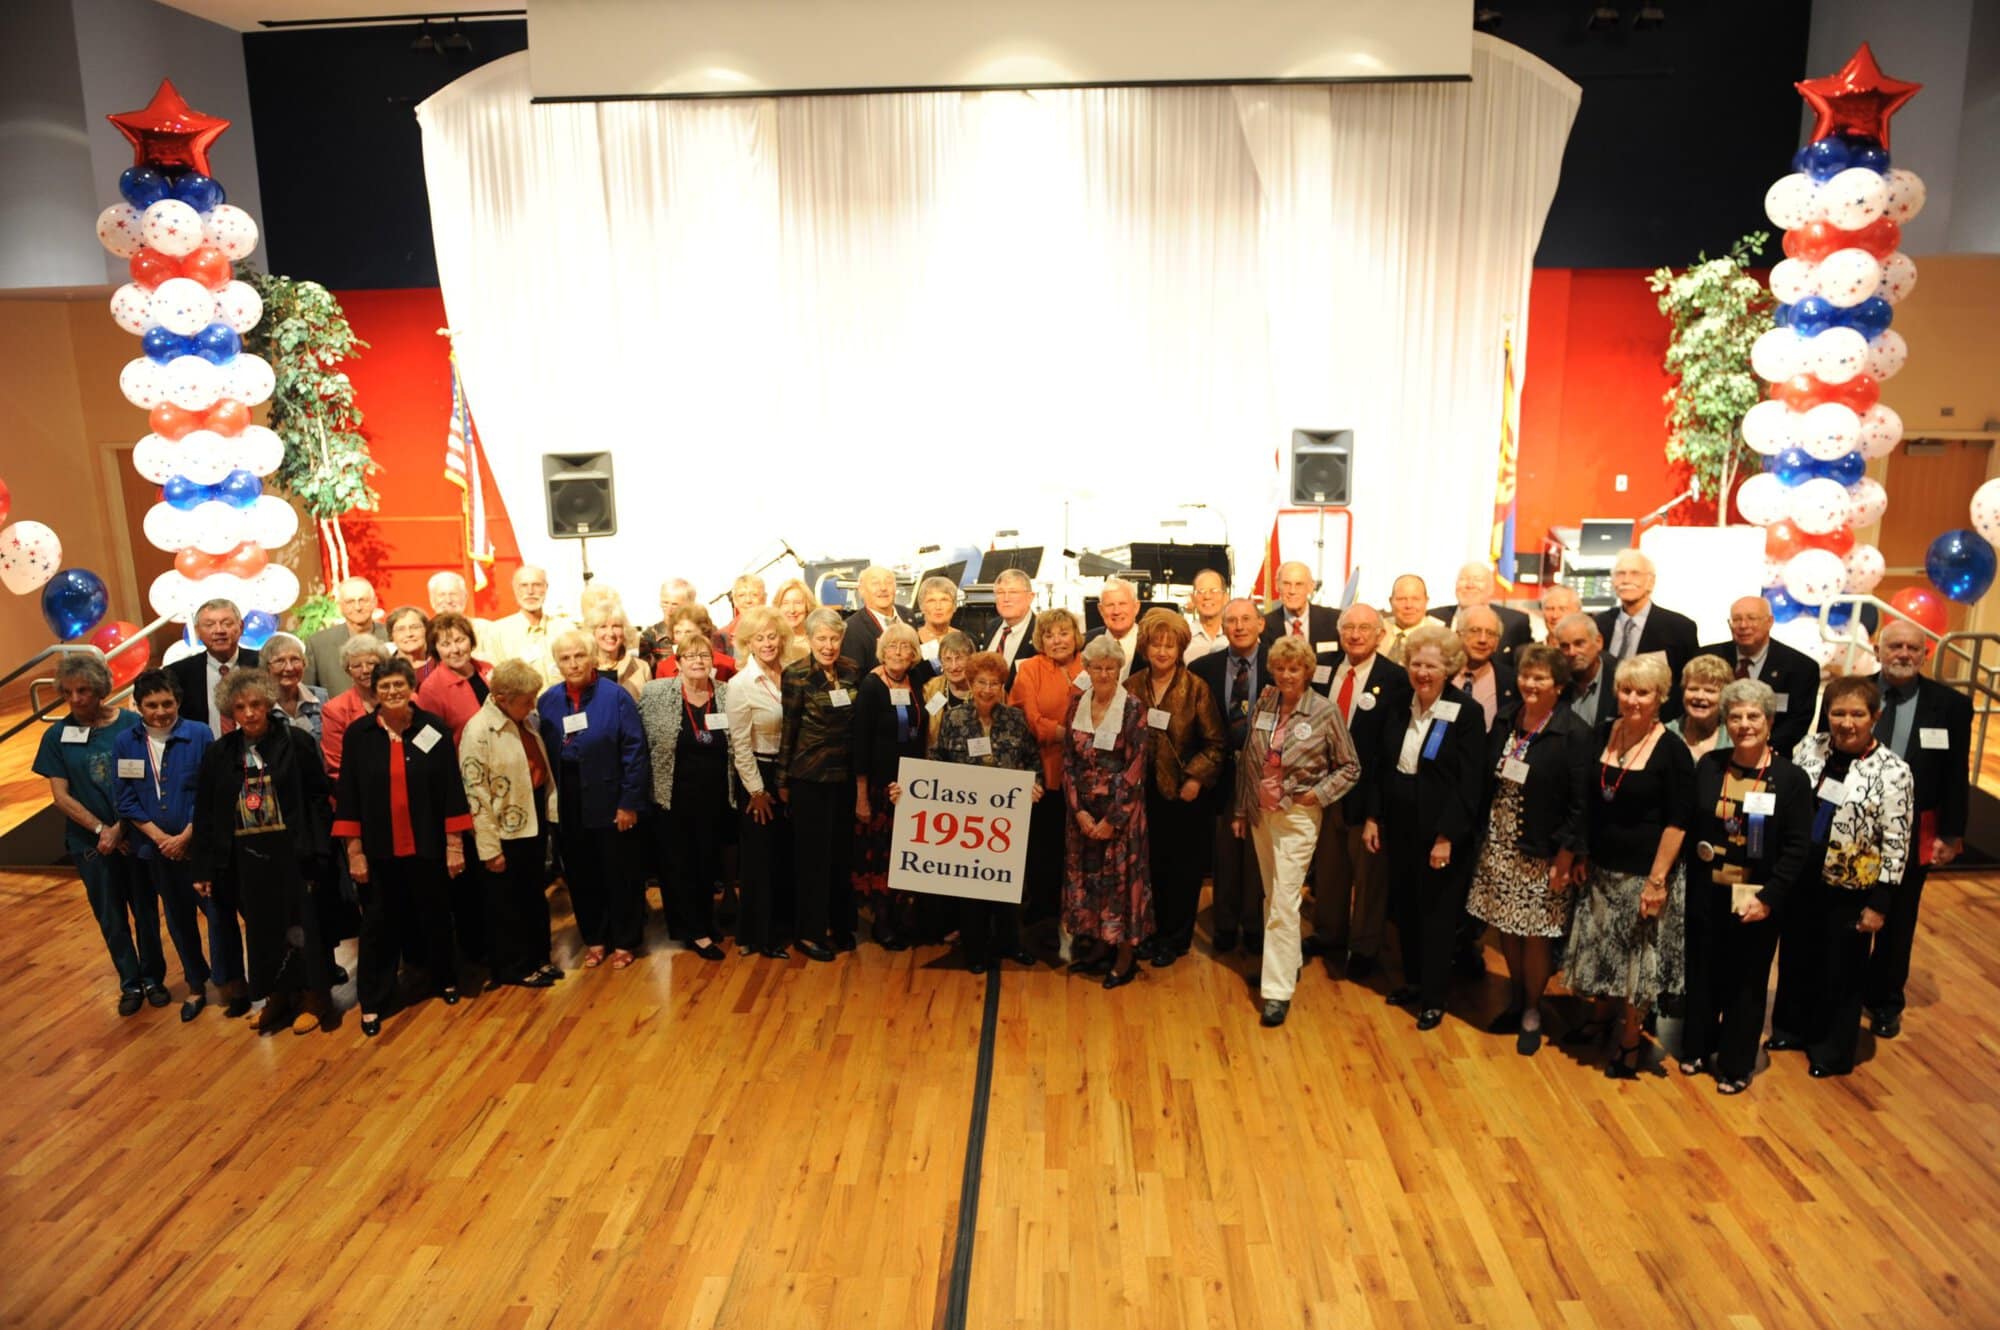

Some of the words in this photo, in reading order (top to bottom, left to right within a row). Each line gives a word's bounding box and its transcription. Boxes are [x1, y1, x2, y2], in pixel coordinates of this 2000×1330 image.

[908, 778, 978, 805] Class
[989, 787, 1022, 809] of
[909, 810, 1012, 853] 1958
[899, 850, 1012, 883] Reunion
